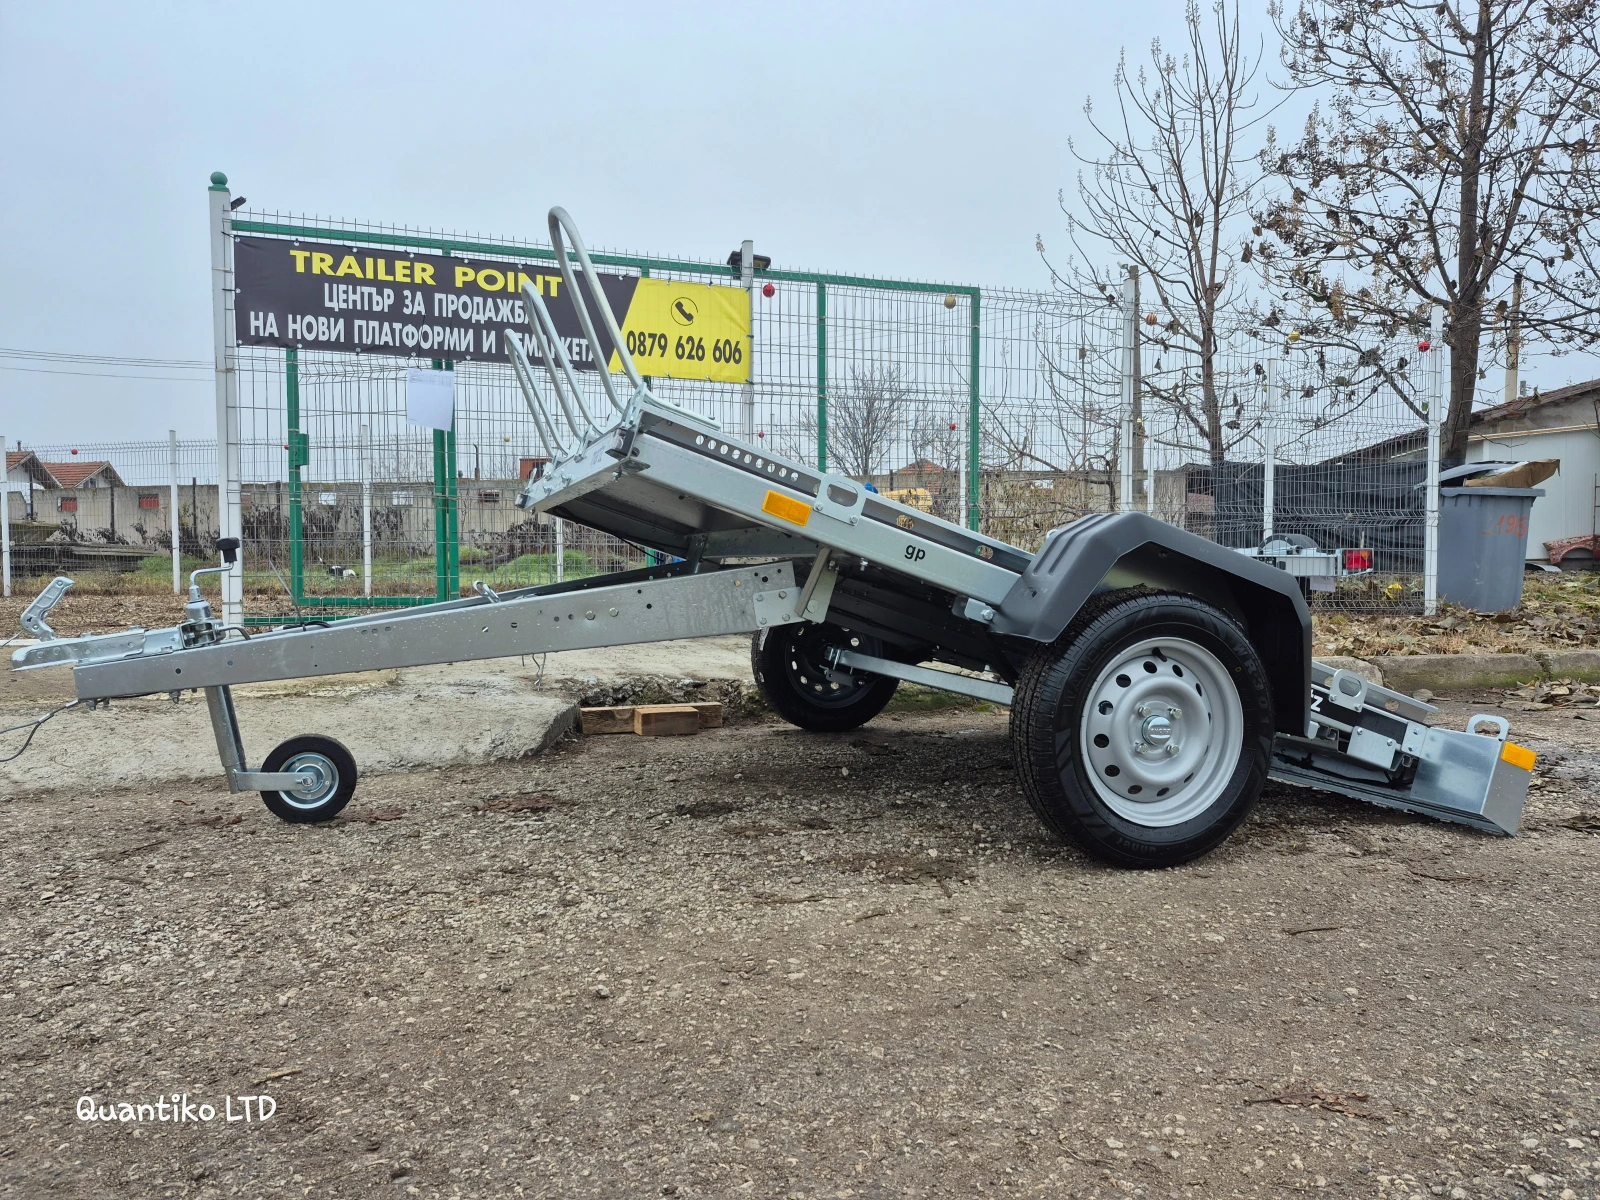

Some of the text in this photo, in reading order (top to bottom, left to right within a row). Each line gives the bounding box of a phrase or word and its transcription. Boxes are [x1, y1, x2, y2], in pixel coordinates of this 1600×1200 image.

[289, 250, 563, 297] TRAILER POINT
[324, 282, 531, 325] ЦЕНТЪР ЗА ПРОДАЖБ
[250, 311, 279, 338] НА
[288, 314, 345, 343] НОВИ
[354, 319, 474, 354] ПЛАТФОРМИ
[483, 329, 496, 354] И
[626, 330, 742, 365] 0879 626 606
[904, 544, 926, 562] gp
